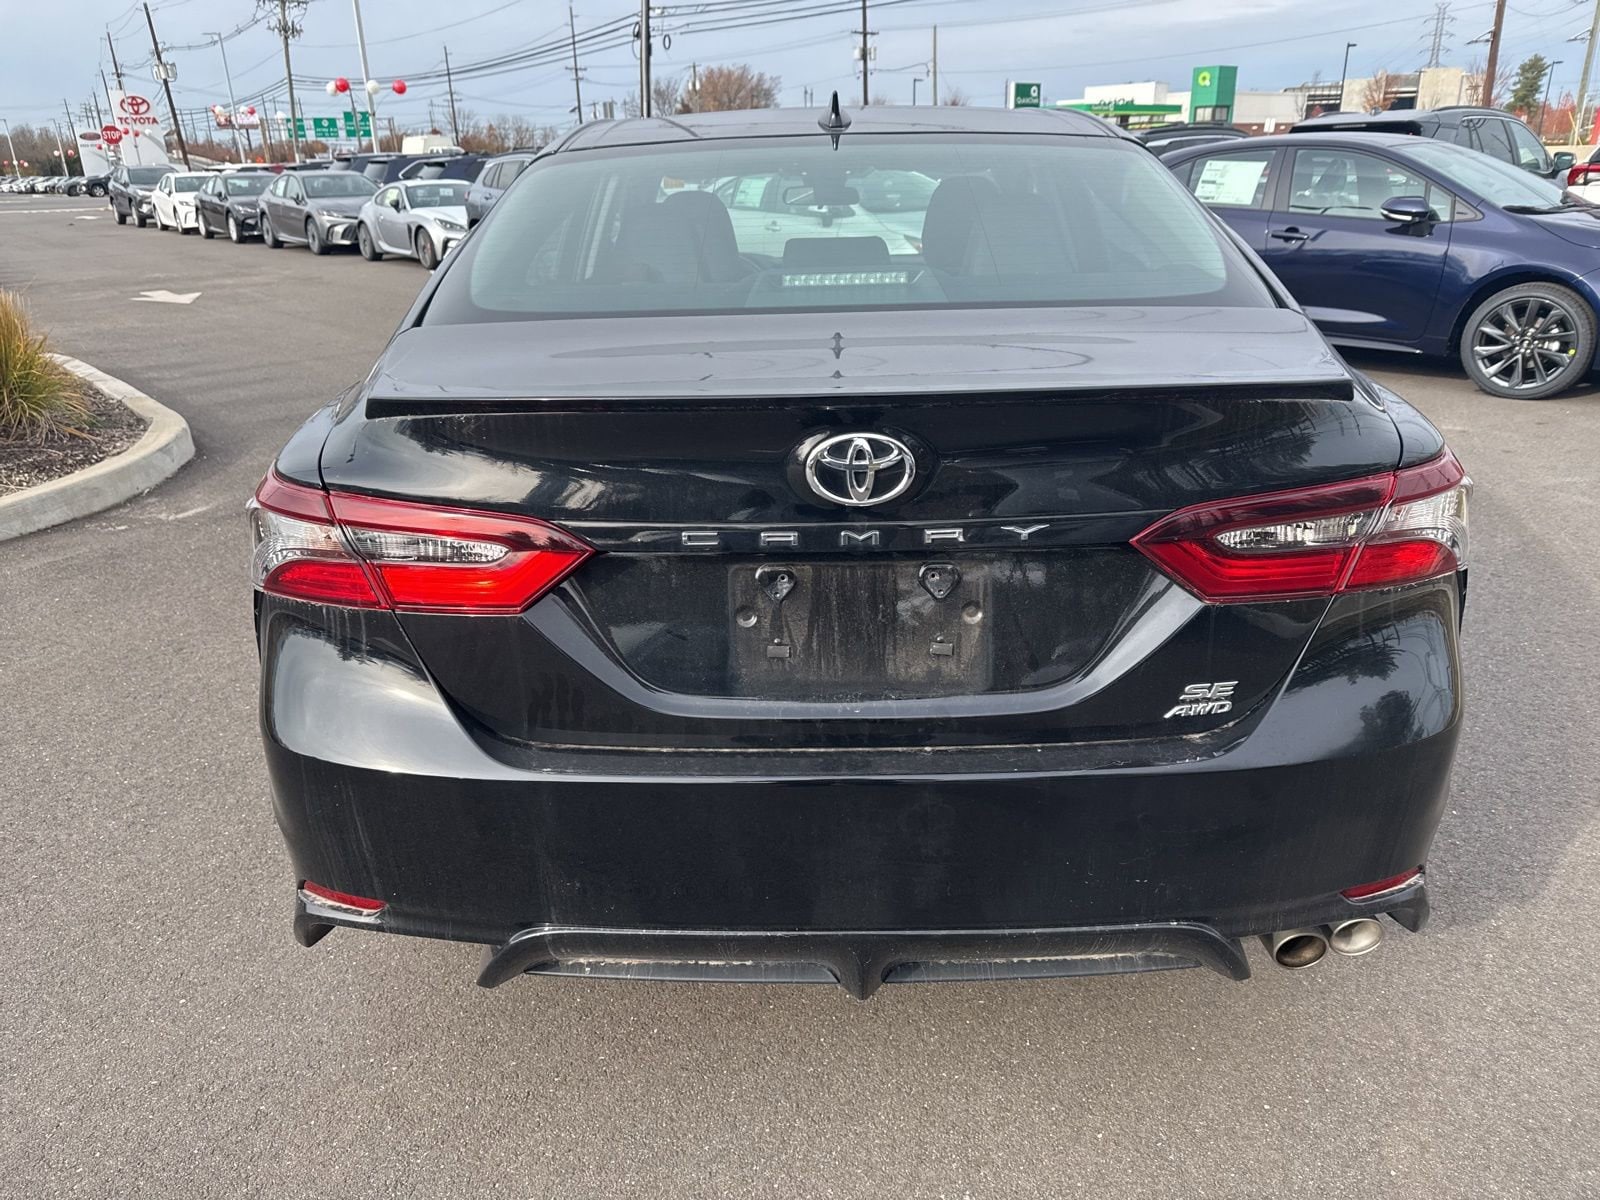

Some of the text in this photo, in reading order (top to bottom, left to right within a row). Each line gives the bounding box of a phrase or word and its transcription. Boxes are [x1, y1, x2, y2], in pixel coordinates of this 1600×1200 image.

[117, 116, 159, 125] TOYOTA
[103, 131, 121, 140] STOP
[682, 524, 1050, 546] CAMRY
[1179, 680, 1239, 700] SE
[1163, 700, 1233, 719] AWD
